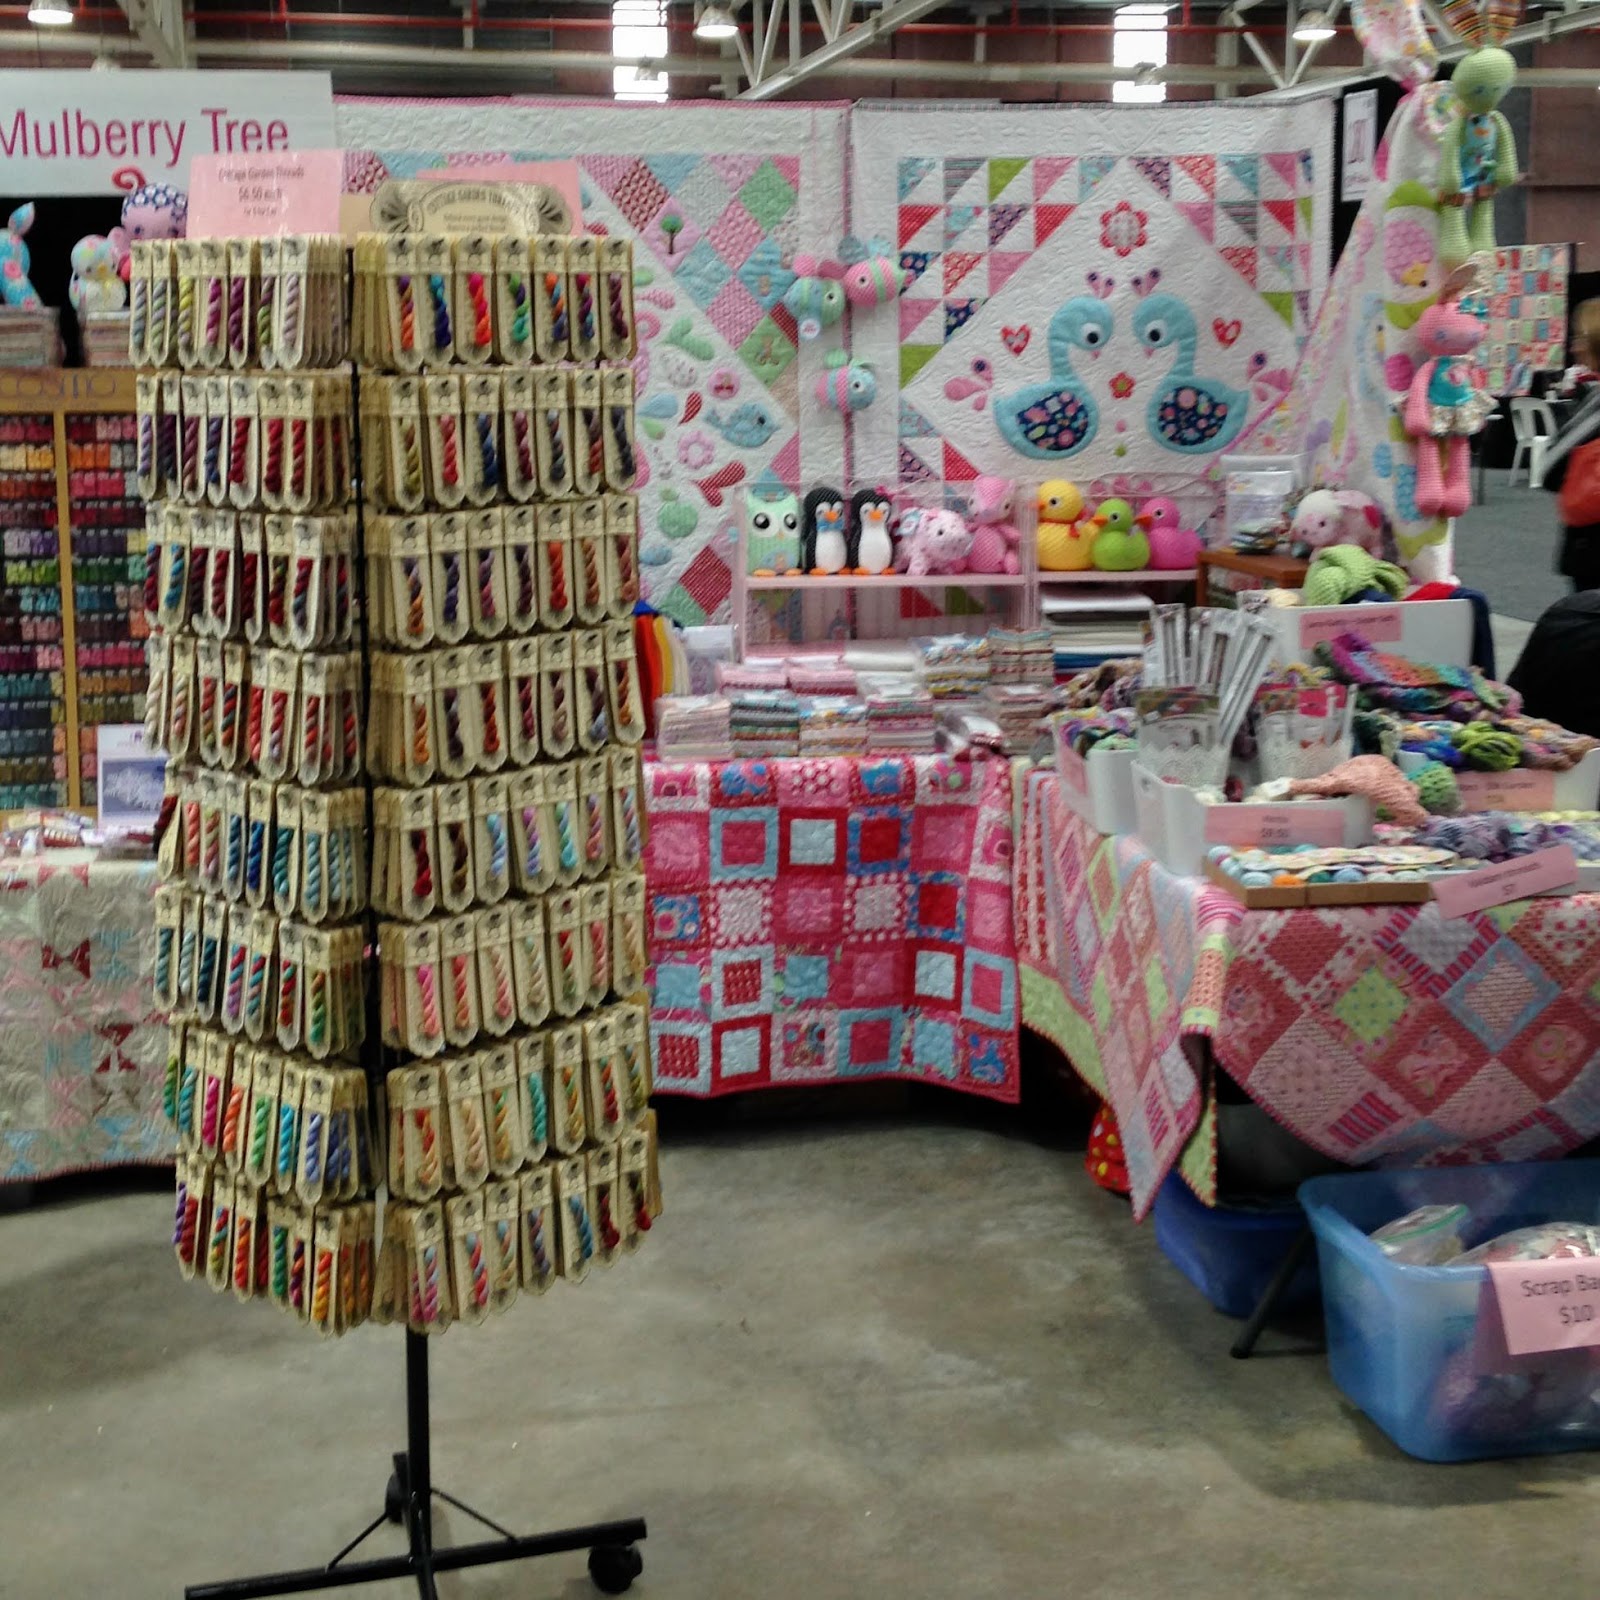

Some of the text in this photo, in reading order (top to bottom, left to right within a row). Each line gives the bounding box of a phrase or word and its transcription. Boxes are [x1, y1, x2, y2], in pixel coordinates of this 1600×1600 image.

[0, 107, 289, 168] Mulberry Tree
[1520, 1280, 1573, 1298] Scrap
[1560, 1304, 1594, 1327] $10
